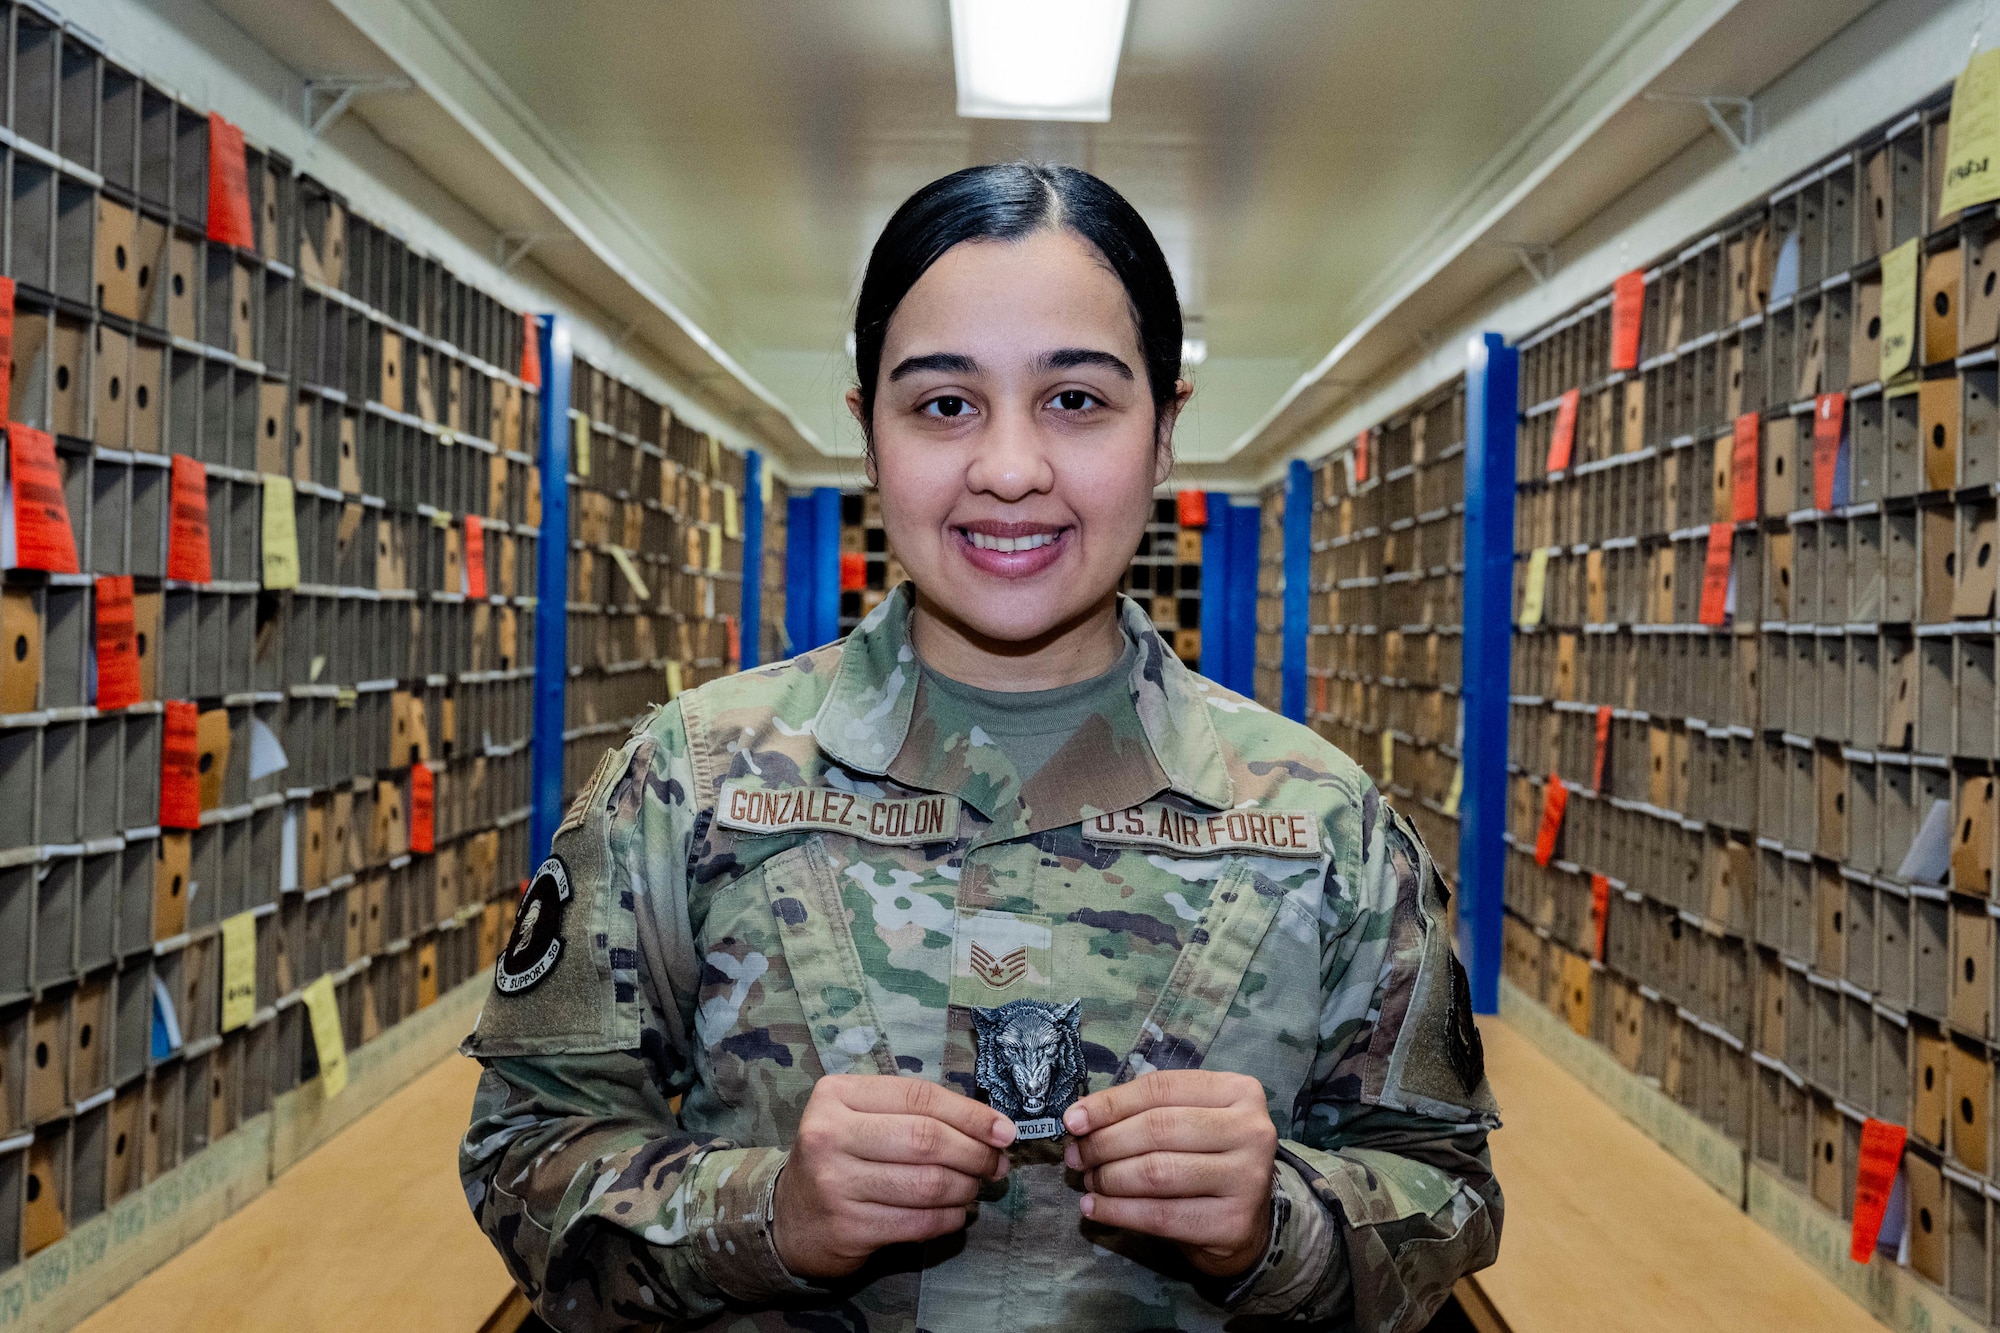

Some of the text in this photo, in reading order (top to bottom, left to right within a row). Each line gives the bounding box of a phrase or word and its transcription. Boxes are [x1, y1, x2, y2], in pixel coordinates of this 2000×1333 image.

[730, 788, 947, 837] GONZALEZ-COLON
[1095, 805, 1309, 850] U.S. AIR FORCE
[558, 875, 567, 894] US
[509, 961, 546, 989] SUPPORT
[1018, 1124, 1046, 1135] WOLF
